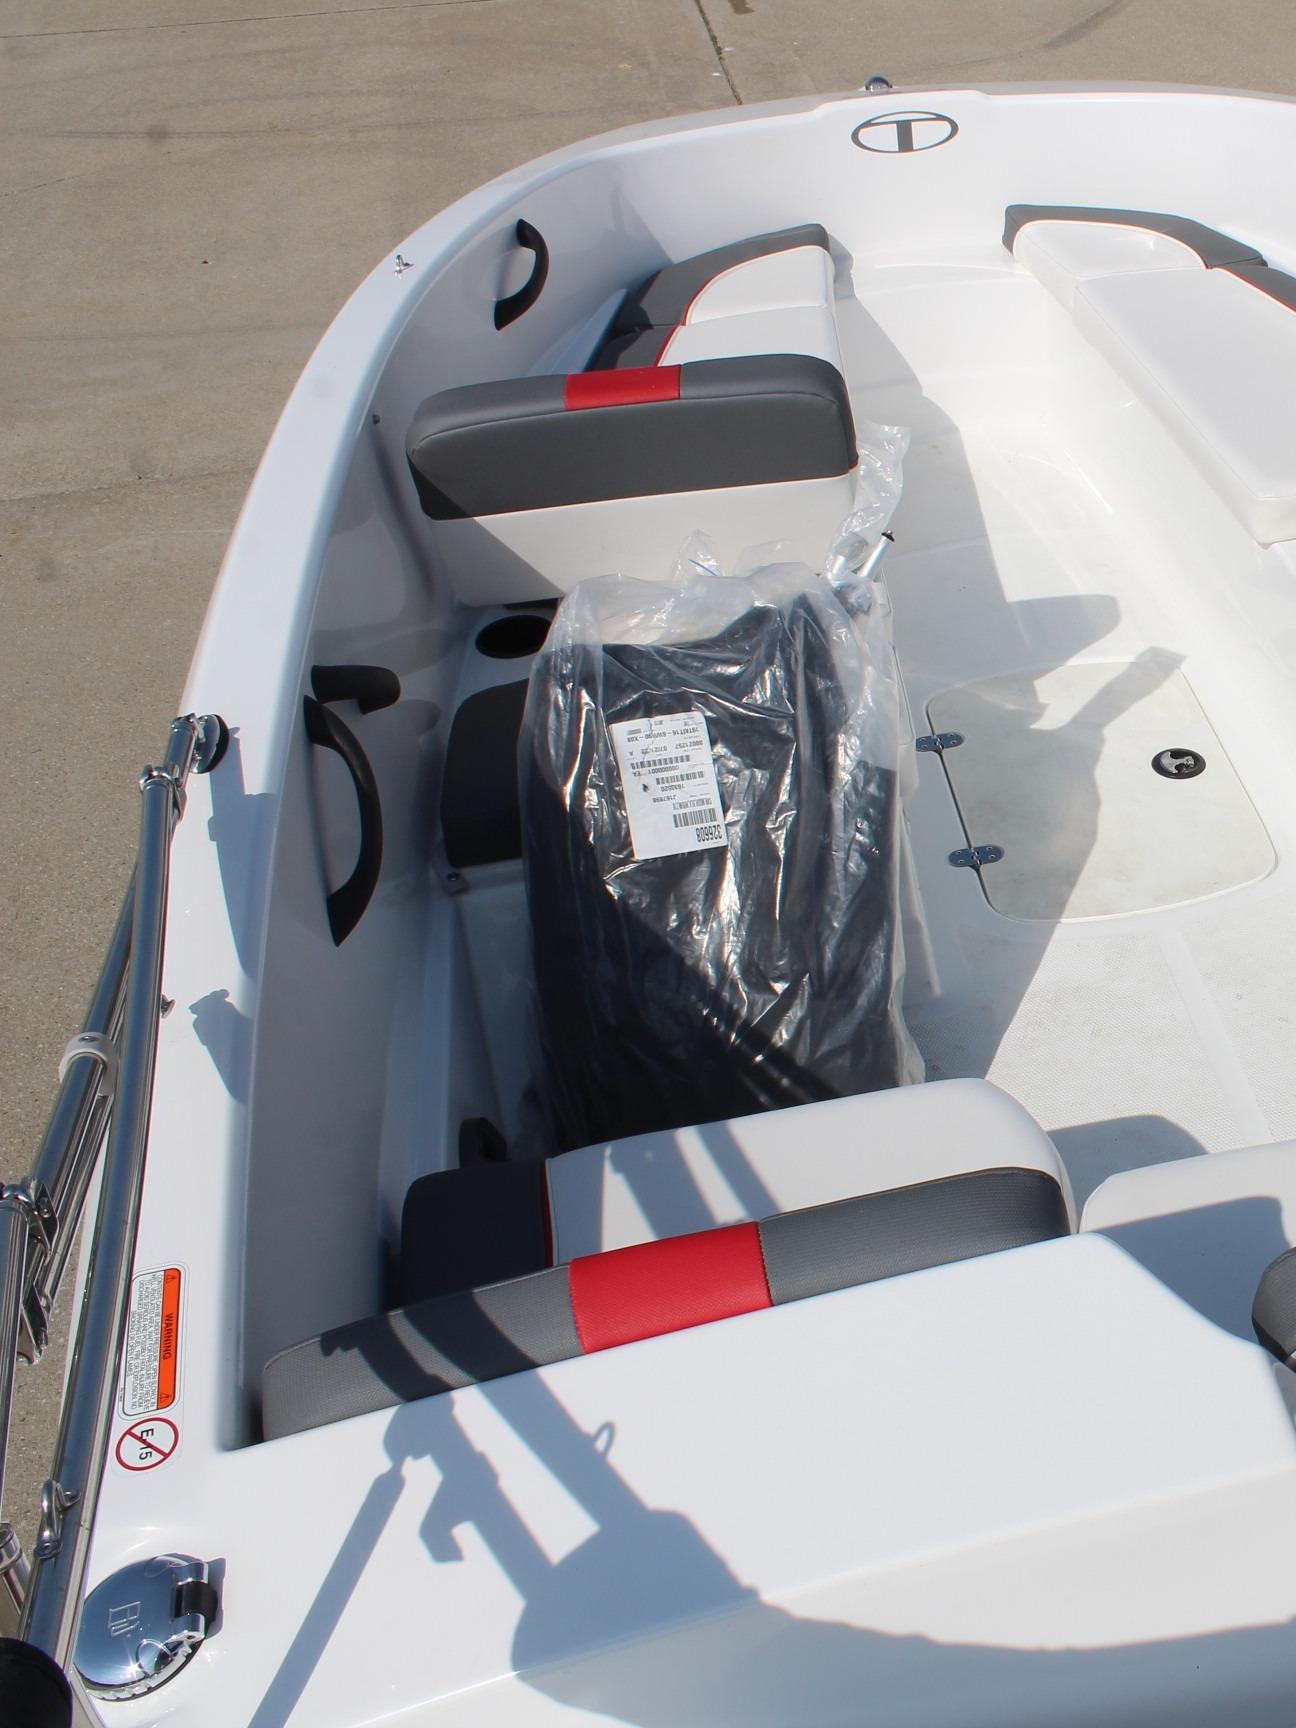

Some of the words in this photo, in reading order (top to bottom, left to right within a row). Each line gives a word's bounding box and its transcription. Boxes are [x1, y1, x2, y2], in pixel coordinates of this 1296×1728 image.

[695, 824, 722, 842] 326608
[136, 1279, 144, 1310] DISCHARGED
[148, 1287, 156, 1314] VENTILATED
[128, 1333, 135, 1341] OR
[162, 1312, 173, 1360] WARNING
[133, 1361, 139, 1370] OR
[144, 1381, 150, 1390] TO
[131, 1401, 137, 1409] NO
